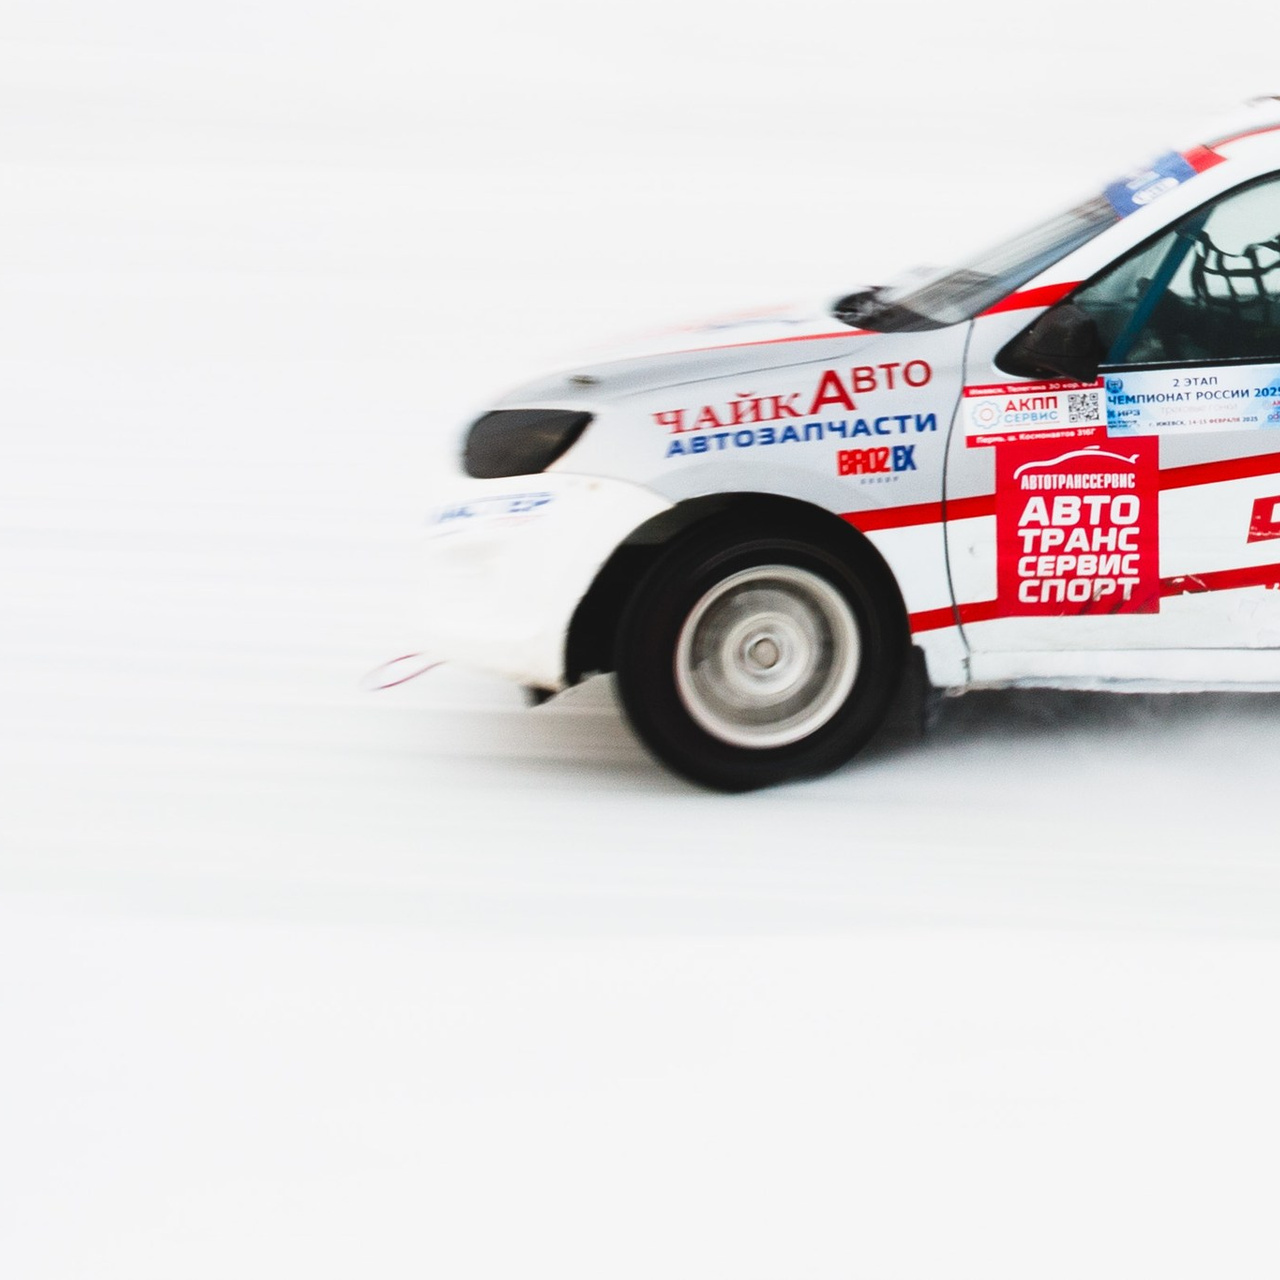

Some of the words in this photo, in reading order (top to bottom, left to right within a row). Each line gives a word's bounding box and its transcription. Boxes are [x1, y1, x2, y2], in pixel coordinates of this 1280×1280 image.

[1173, 378, 1181, 388] 2
[1184, 377, 1218, 387] ЭТАП
[1004, 396, 1059, 412] АКПП
[1107, 392, 1192, 406] ЧЕМПИОНАТ
[1196, 388, 1250, 401] РОССИИ
[1004, 410, 1059, 423] СЕРВИС
[664, 412, 938, 459] АВТОЗАПЧАСТИ
[1020, 473, 1136, 491] АВТОТРАНССЕРВИС
[1017, 494, 1140, 527] АВТО
[1017, 527, 1140, 554] ТРАНС
[1017, 553, 1140, 578] СЕРВИС
[1017, 577, 1140, 604] СПОРТ
